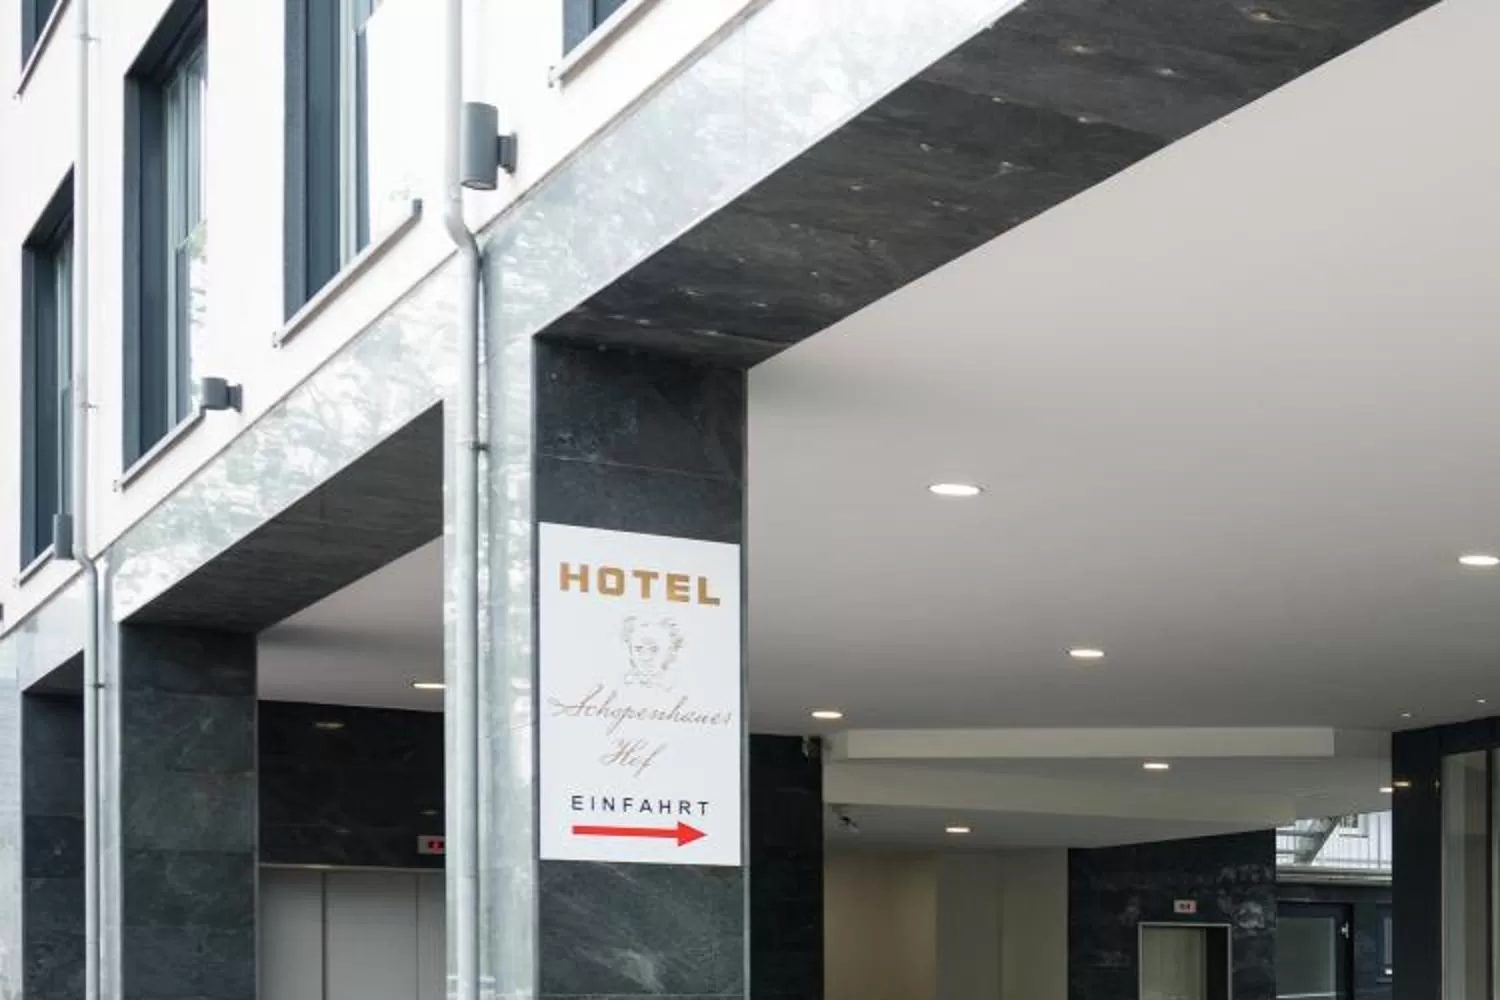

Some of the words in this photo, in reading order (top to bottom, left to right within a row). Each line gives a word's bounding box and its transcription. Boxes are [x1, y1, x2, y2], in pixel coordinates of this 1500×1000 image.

[559, 562, 721, 606] HOTEL
[599, 738, 668, 778] Hof
[571, 795, 709, 816] EINFAHRT
